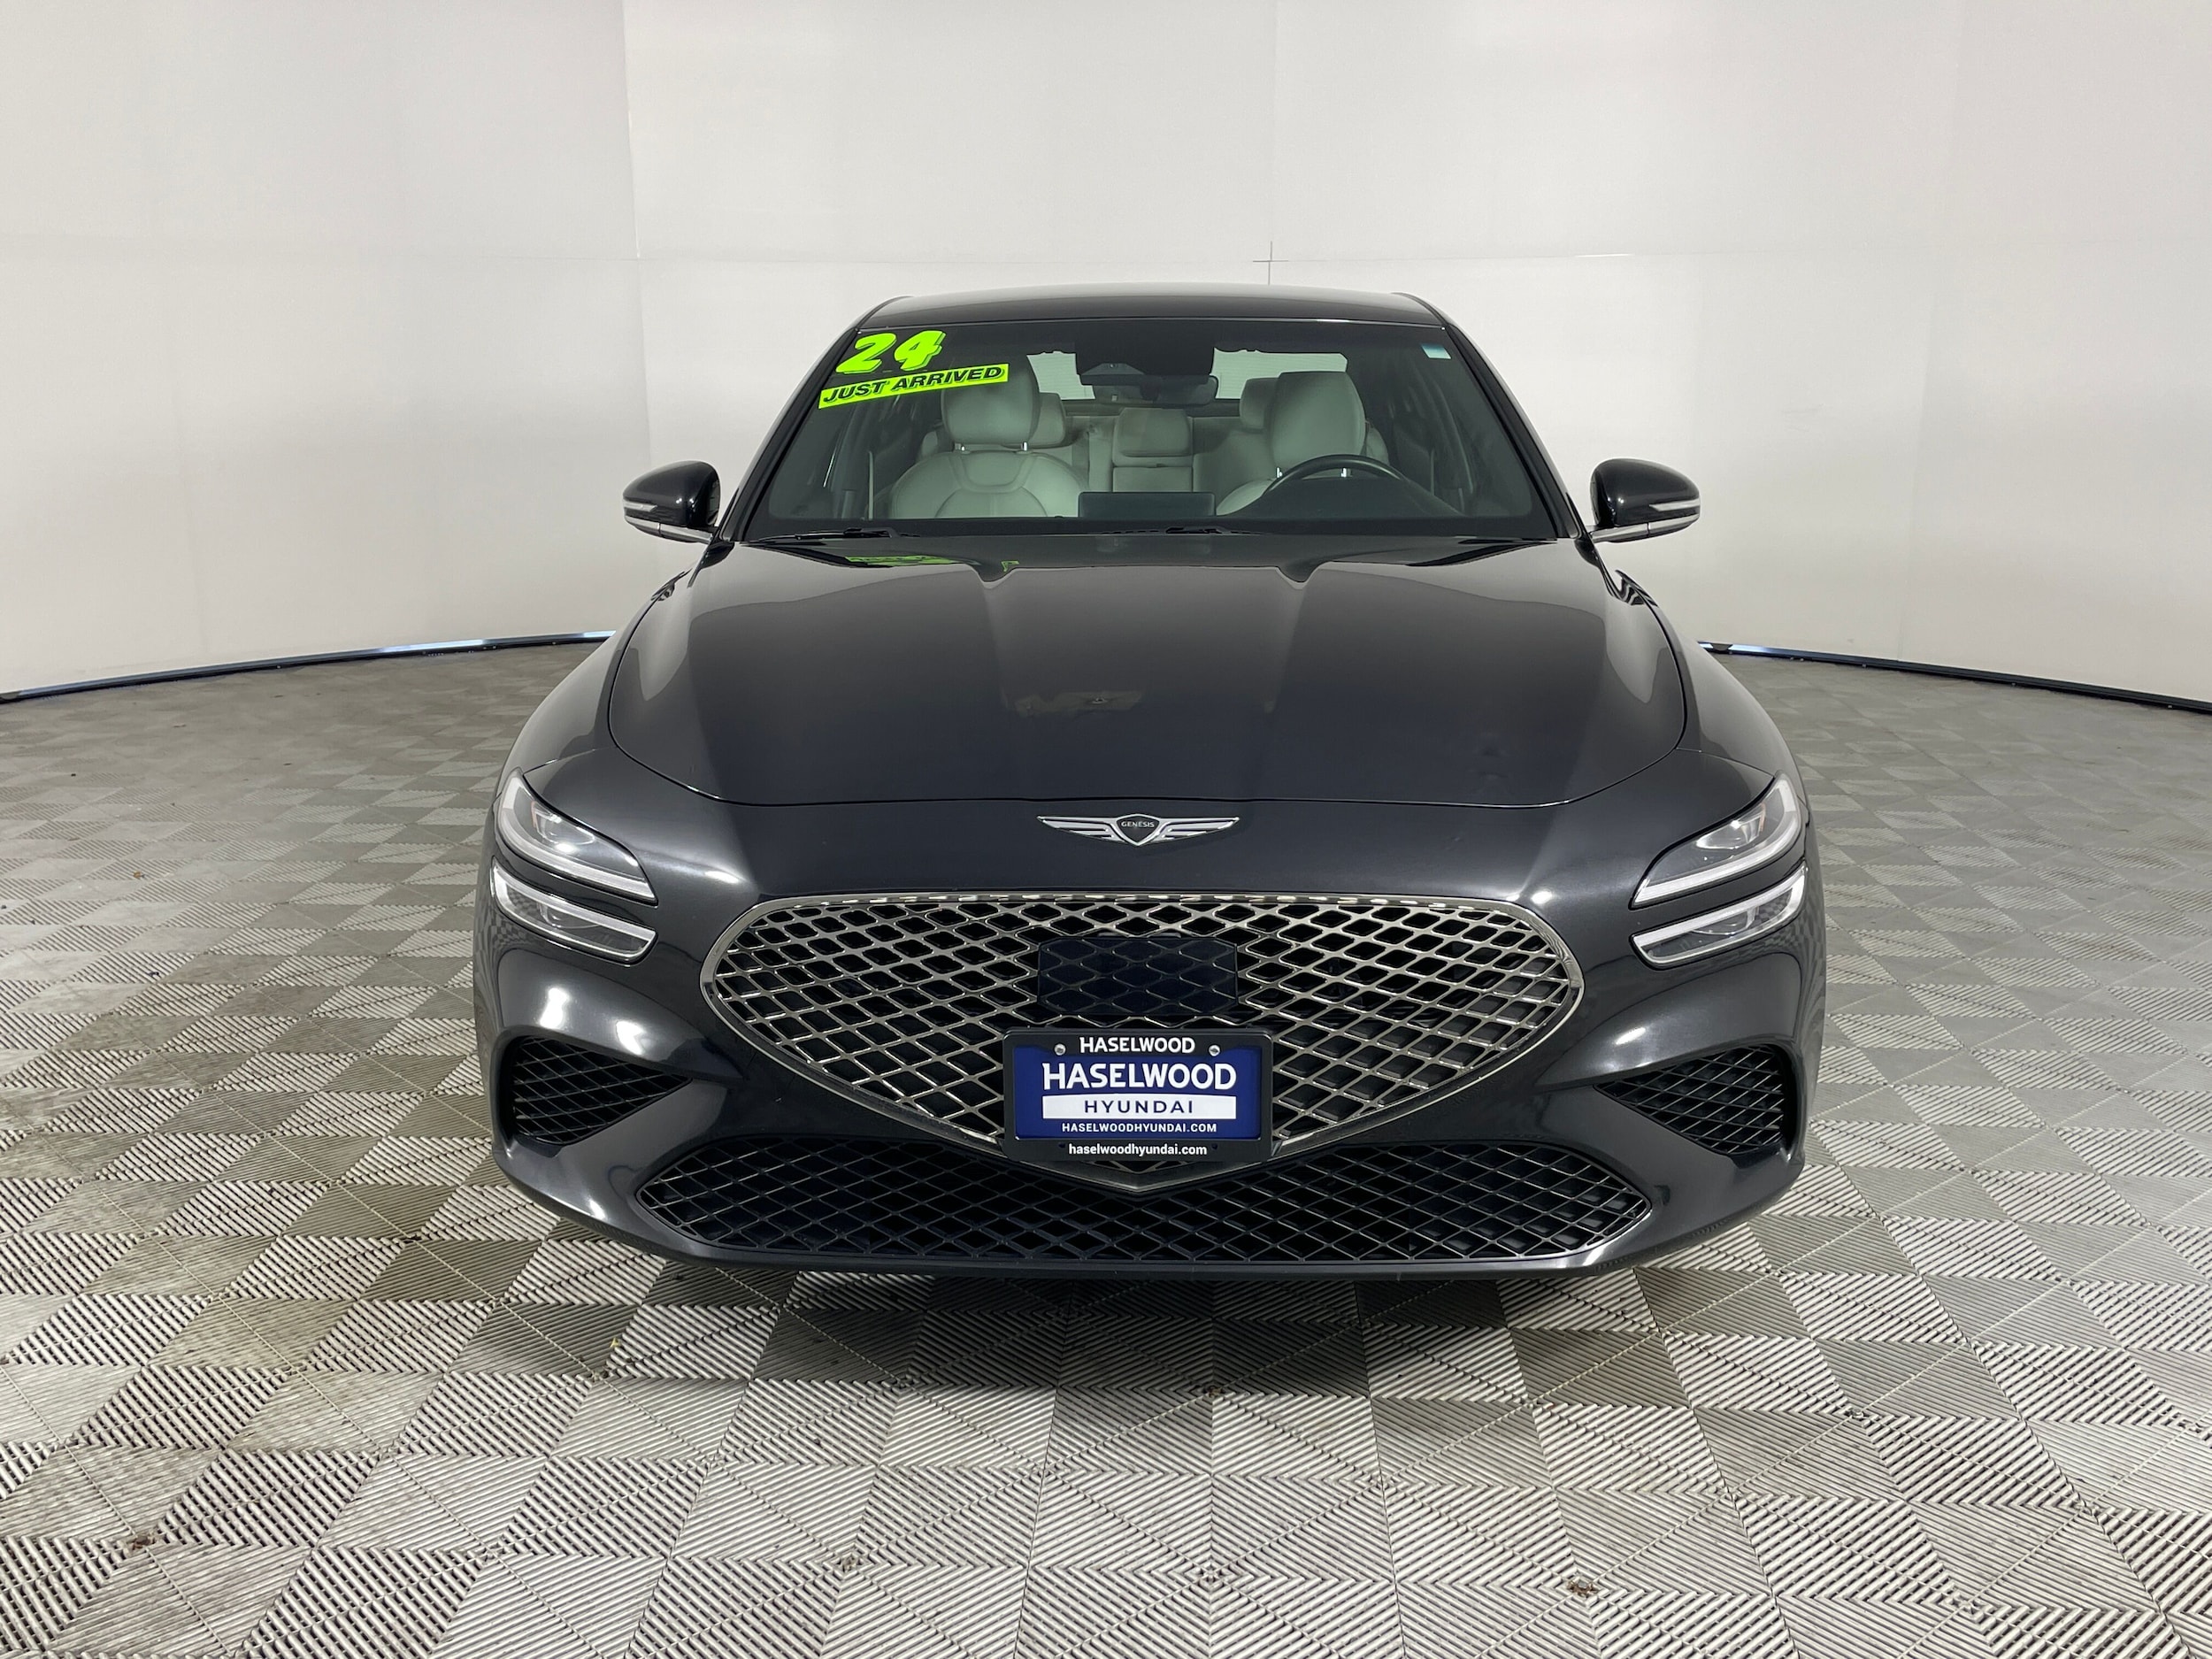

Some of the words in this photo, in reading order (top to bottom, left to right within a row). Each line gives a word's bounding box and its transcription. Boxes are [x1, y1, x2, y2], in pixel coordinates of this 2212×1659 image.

[835, 330, 946, 374] 24
[823, 380, 888, 403] JUST
[891, 366, 1005, 390] ARRIVED
[1079, 1037, 1195, 1054] HASELWOOD
[1042, 1063, 1237, 1090] HASELWOOD
[1084, 1100, 1194, 1114] HYUNDAI
[1062, 1123, 1217, 1133] HASELWOODHYUNDAI.COM
[1068, 1143, 1207, 1156] haselwoodhyundai.com
